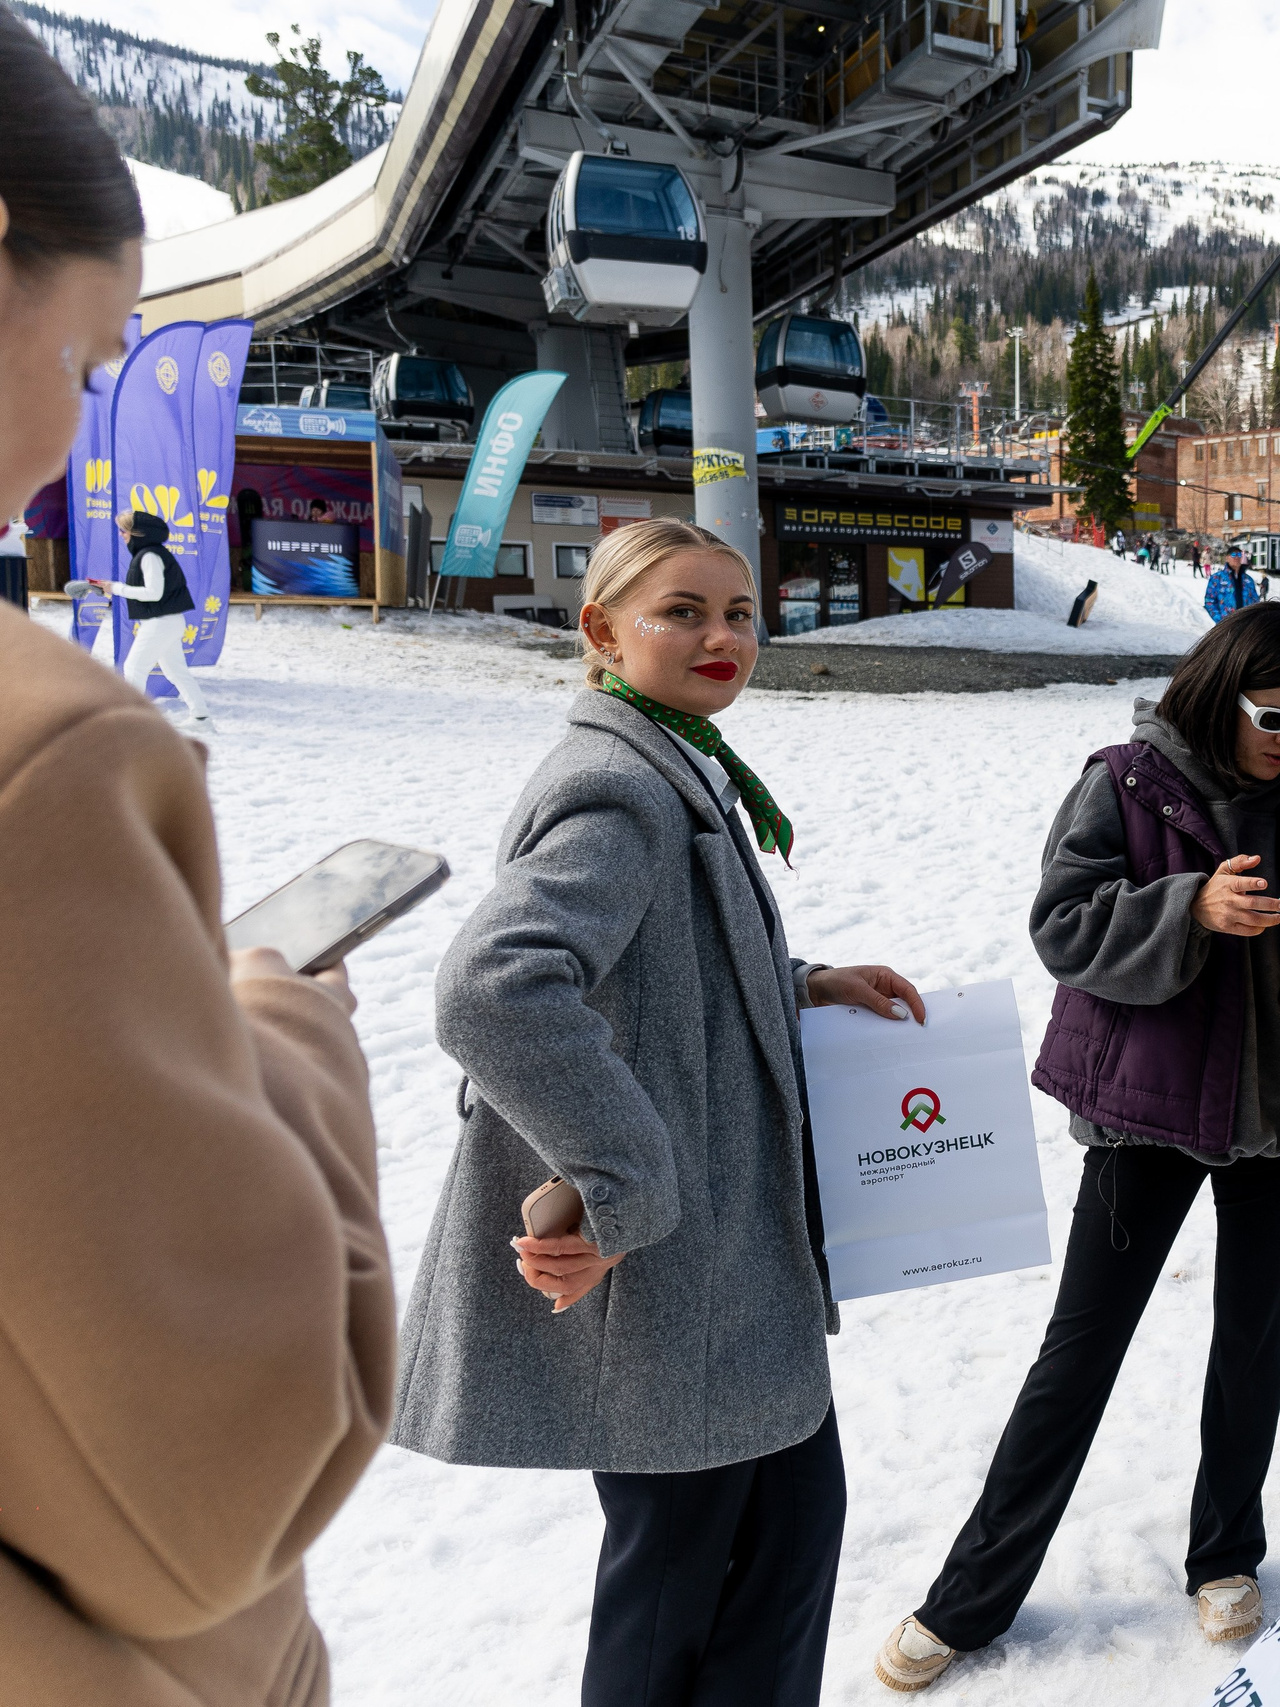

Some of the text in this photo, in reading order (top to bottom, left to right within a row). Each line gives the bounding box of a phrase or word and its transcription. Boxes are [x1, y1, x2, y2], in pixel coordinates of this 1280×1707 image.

[677, 226, 696, 240] 18
[473, 411, 523, 498] ИНФО
[291, 498, 375, 522] ОДЖДА
[784, 524, 962, 540] магазин спортивной экипировки
[267, 540, 343, 554] ШЕРЕГЕШ
[857, 1131, 995, 1167] НОВОКУЗНЕЦК
[859, 1157, 936, 1177] международный
[860, 1172, 905, 1186] аэропорт
[901, 1255, 983, 1277] www.aerokuz.ru
